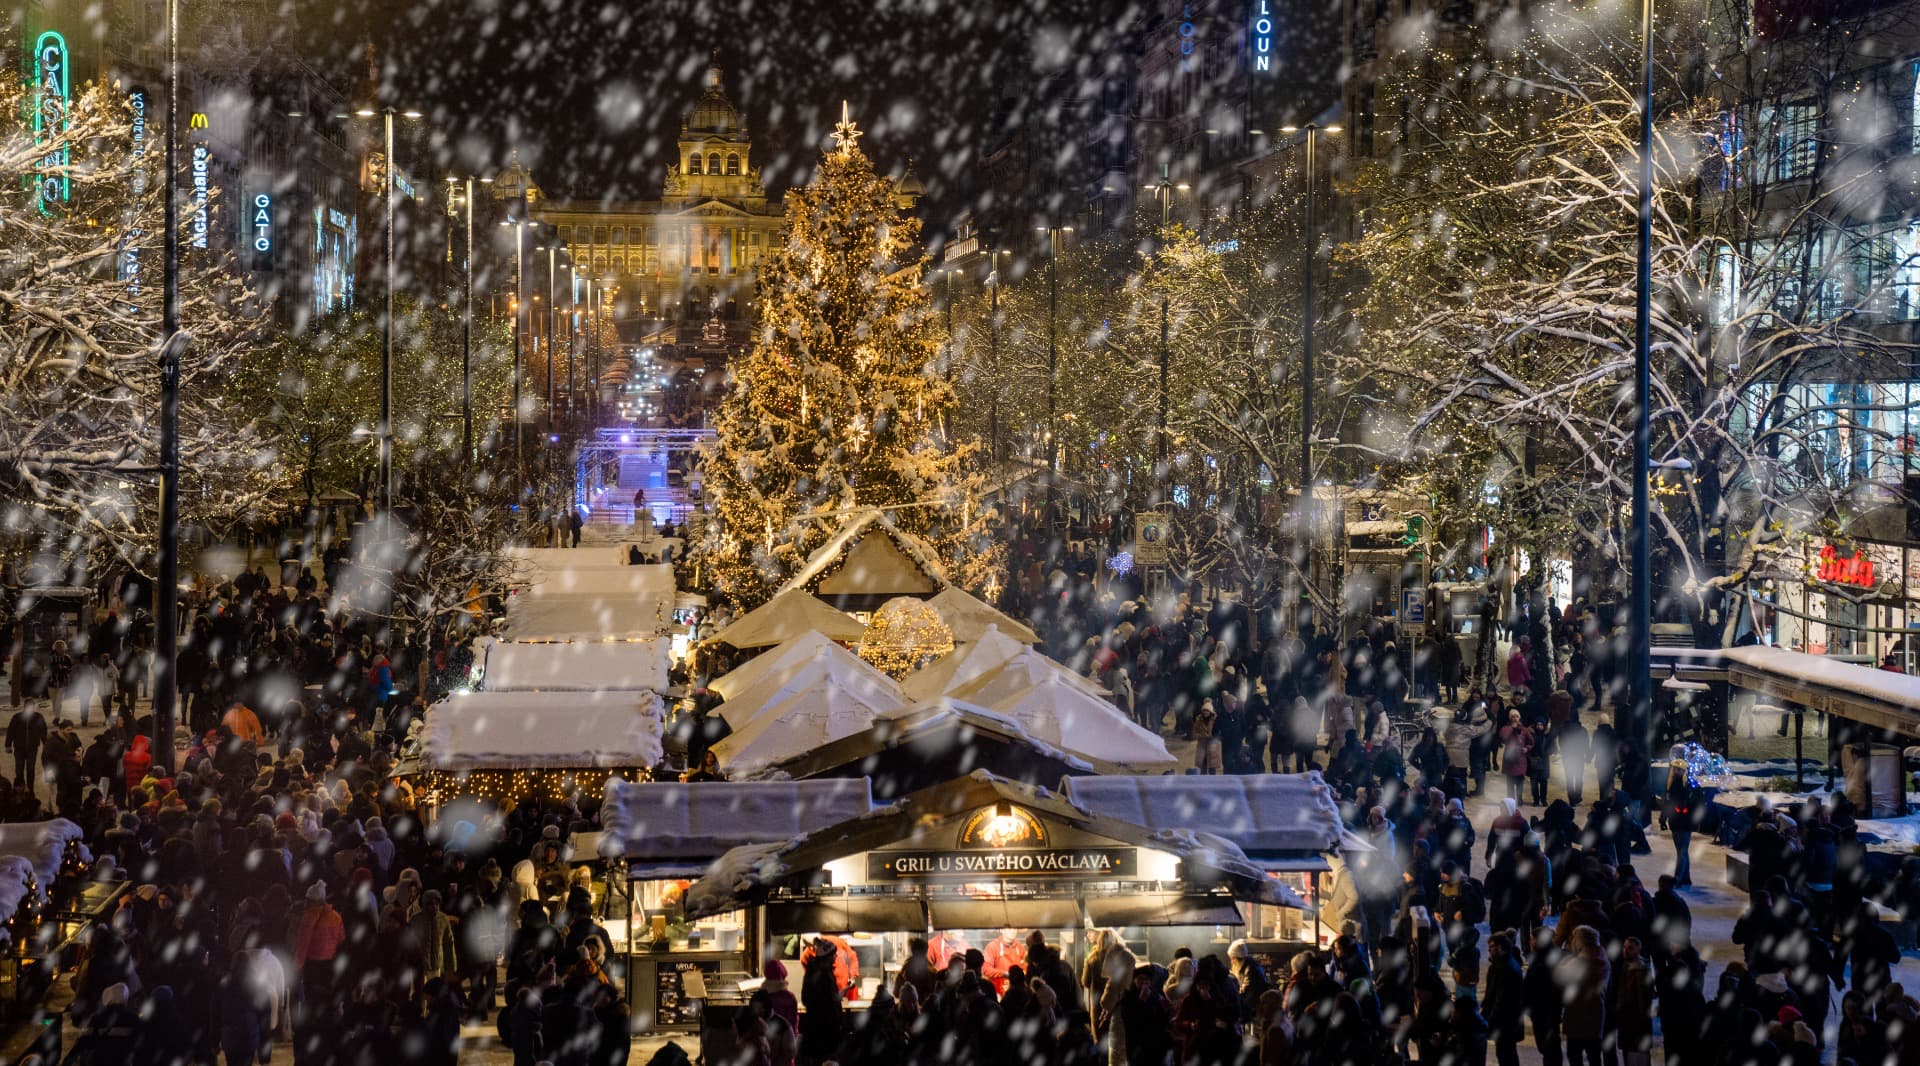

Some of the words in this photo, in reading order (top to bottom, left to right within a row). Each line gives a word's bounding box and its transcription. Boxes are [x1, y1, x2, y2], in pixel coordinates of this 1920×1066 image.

[895, 858, 935, 873] GRIL
[938, 857, 951, 872] U
[954, 852, 1033, 872] SVATÉHO
[1038, 851, 1112, 870] VÁCLAVA
